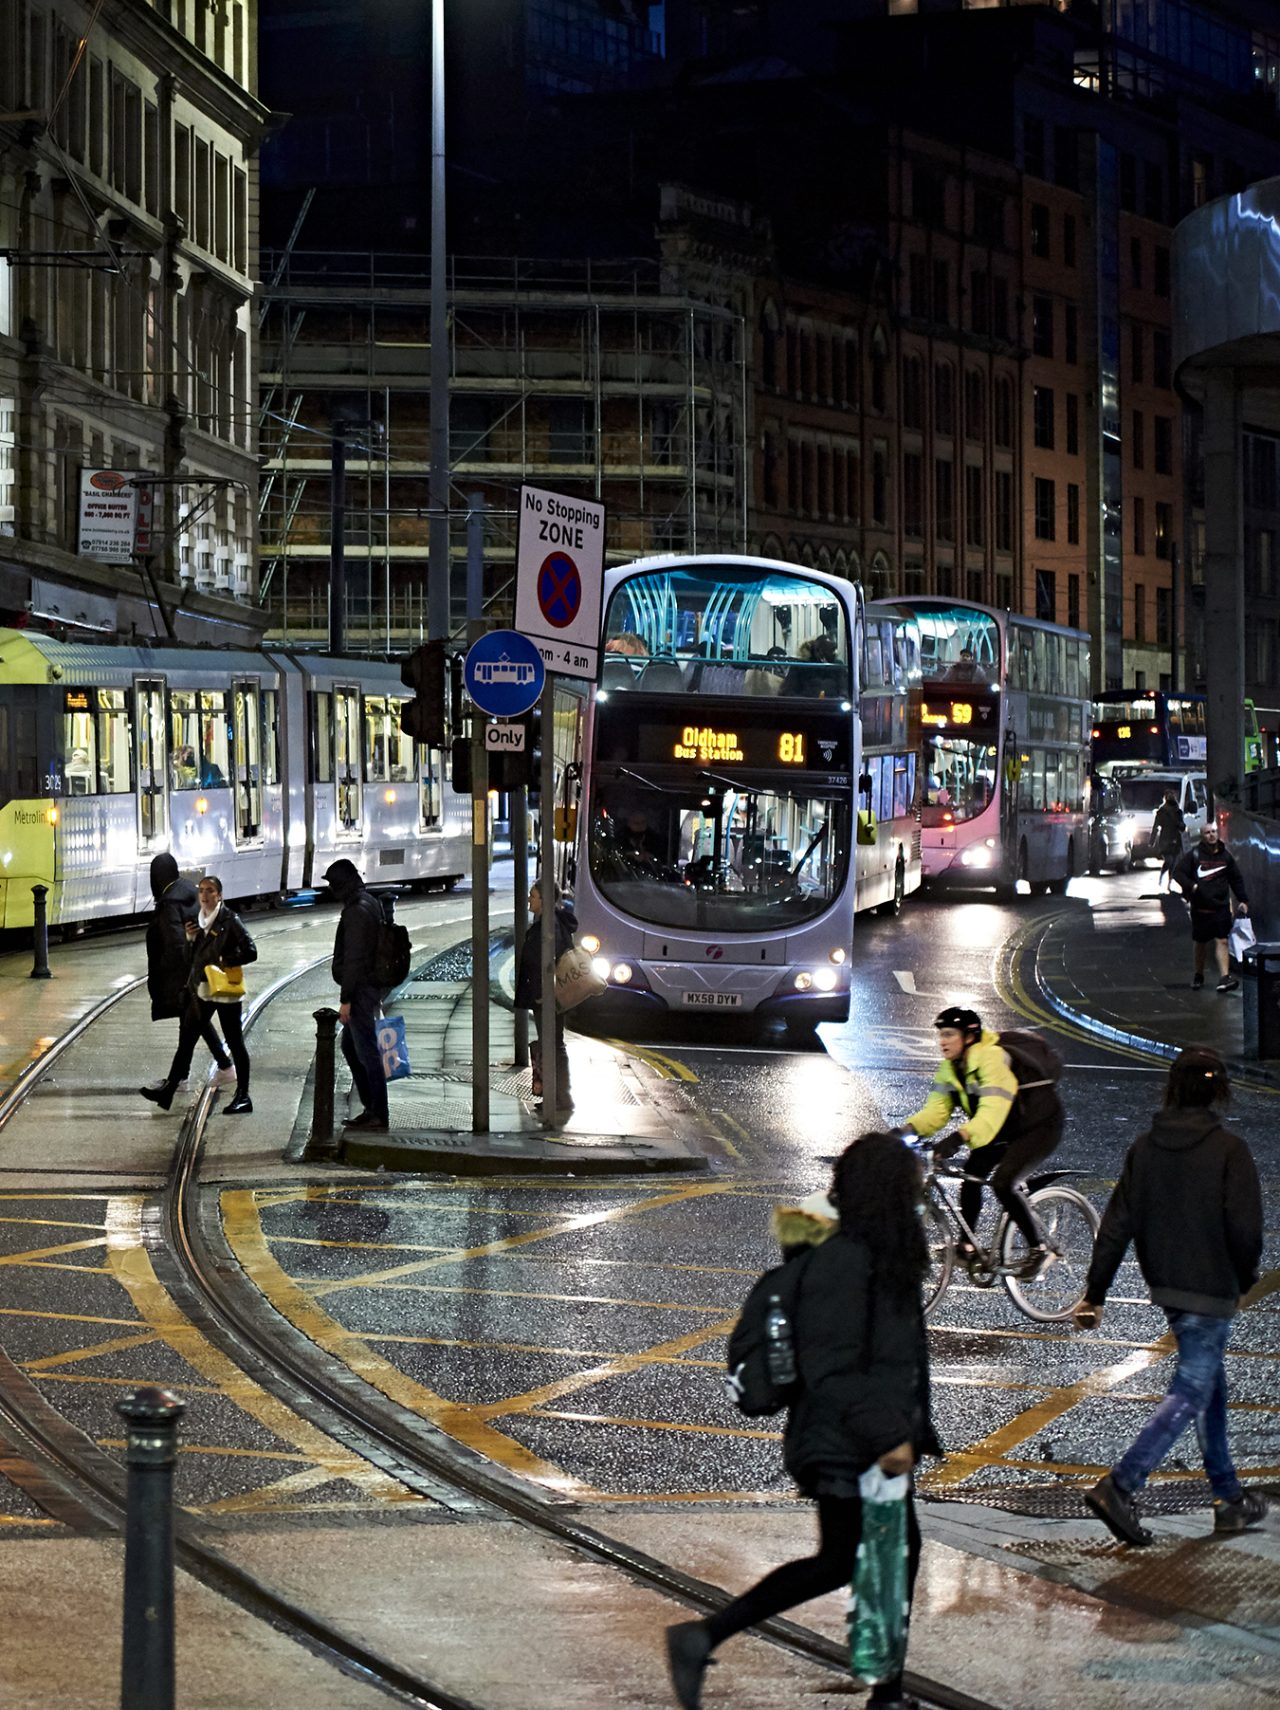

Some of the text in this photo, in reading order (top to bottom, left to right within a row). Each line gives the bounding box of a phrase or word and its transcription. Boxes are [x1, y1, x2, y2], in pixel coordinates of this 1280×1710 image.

[525, 493, 600, 530] No Stopping
[539, 520, 584, 550] ZONE
[563, 651, 571, 665] 4
[574, 656, 589, 669] am
[952, 703, 972, 723] 59
[488, 729, 523, 746] Only
[683, 727, 803, 762] Oldham 81
[674, 744, 744, 761] Bus Station
[14, 810, 48, 824] Metrolin
[557, 962, 590, 988] M&S
[687, 993, 738, 1005] MX58 DYW
